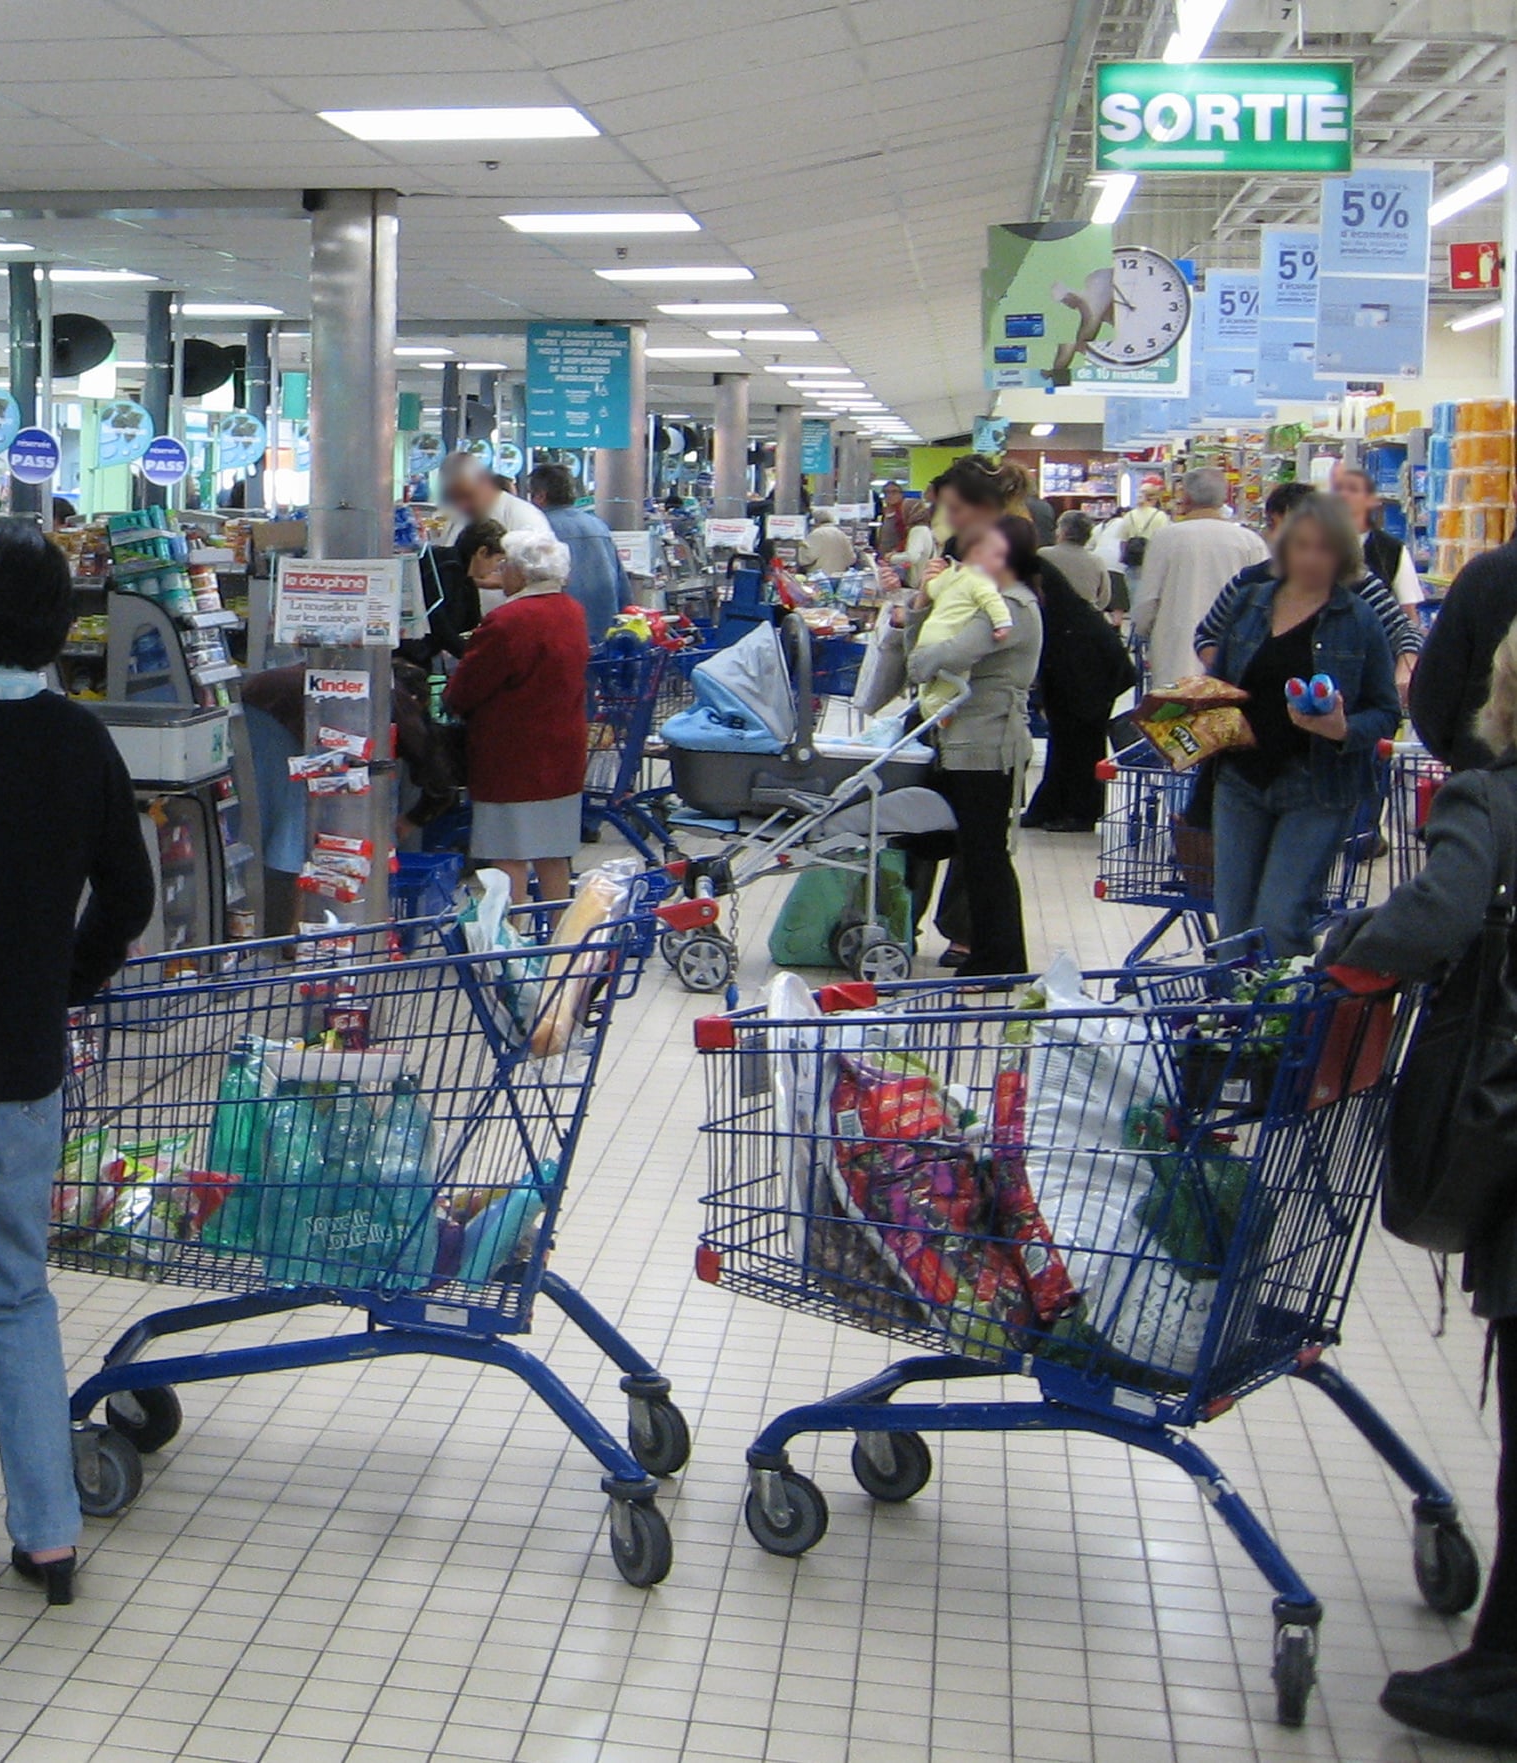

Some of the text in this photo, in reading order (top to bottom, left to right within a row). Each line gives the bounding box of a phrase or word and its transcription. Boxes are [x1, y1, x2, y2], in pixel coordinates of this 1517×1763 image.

[1099, 92, 1349, 143] SORTIE
[1341, 190, 1409, 228] 5%
[1120, 258, 1139, 271] 12
[1146, 266, 1154, 277] 1
[1161, 281, 1173, 292] 2
[1168, 301, 1180, 313] 3
[1160, 322, 1173, 333] 4
[1122, 343, 1136, 356] 6
[1146, 338, 1157, 350] 5
[10, 453, 55, 470] PASS
[145, 459, 184, 472] PASS
[285, 574, 297, 586] le
